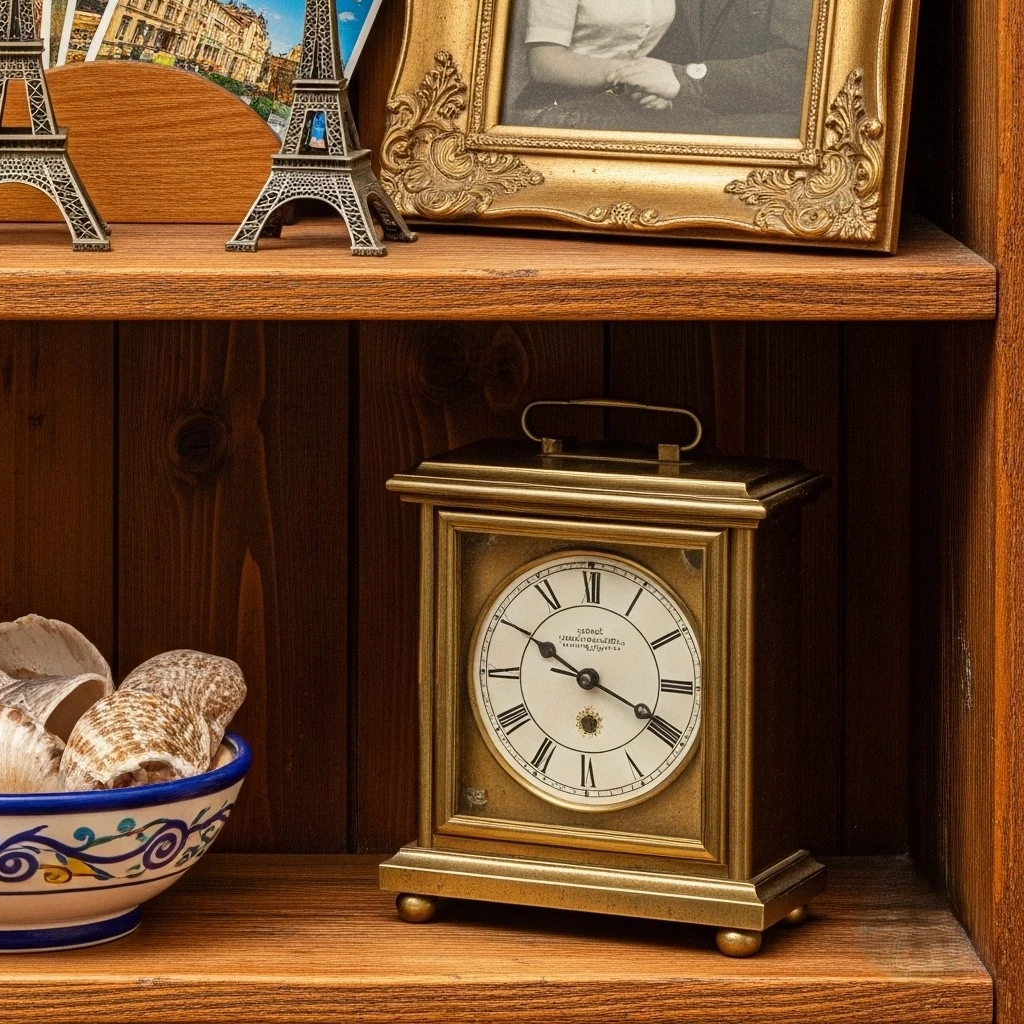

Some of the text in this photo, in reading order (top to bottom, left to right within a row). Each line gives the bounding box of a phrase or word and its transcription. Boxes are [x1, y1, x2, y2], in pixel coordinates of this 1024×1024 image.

[581, 570, 602, 605] XII
[624, 587, 644, 617] I
[650, 628, 682, 651] II
[660, 678, 694, 696] III
[580, 754, 597, 788] VI
